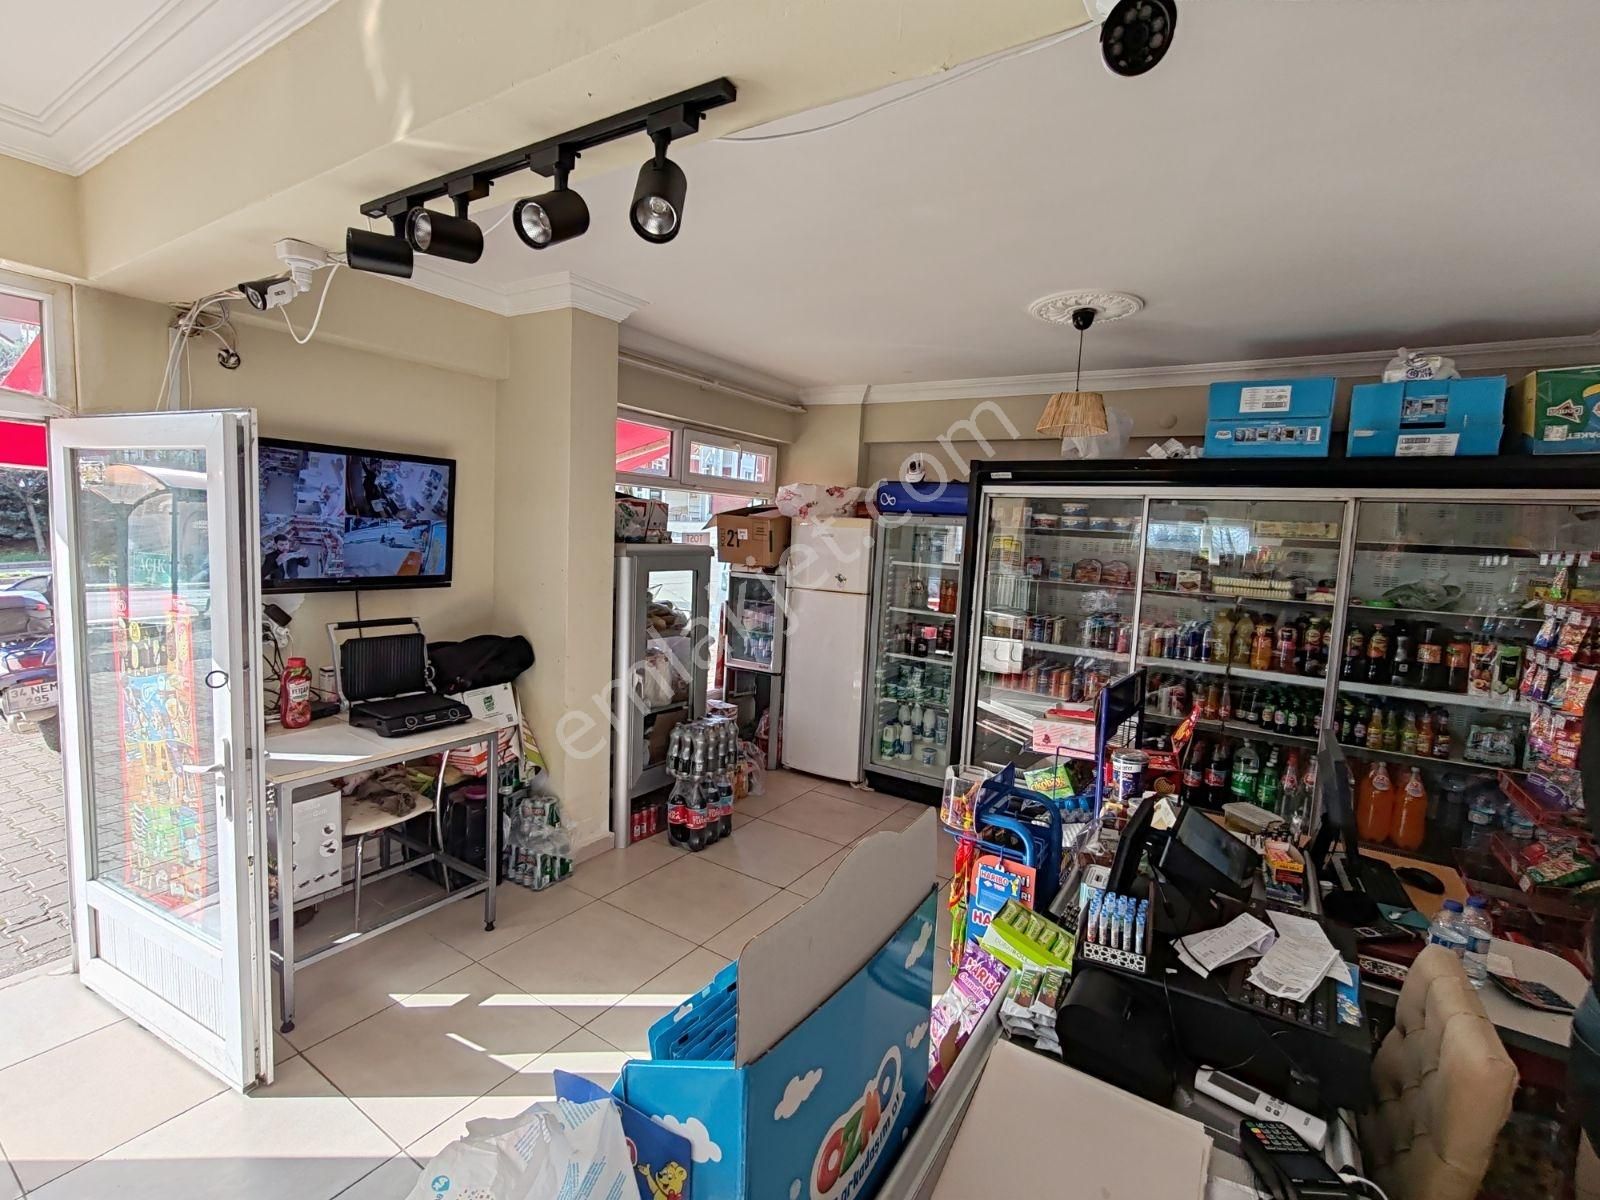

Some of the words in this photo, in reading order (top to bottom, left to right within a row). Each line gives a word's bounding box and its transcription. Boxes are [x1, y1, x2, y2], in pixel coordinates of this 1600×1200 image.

[11, 688, 27, 699] 34
[31, 681, 58, 694] NEM
[26, 694, 49, 706] 295
[981, 870, 1009, 886] HARIBO
